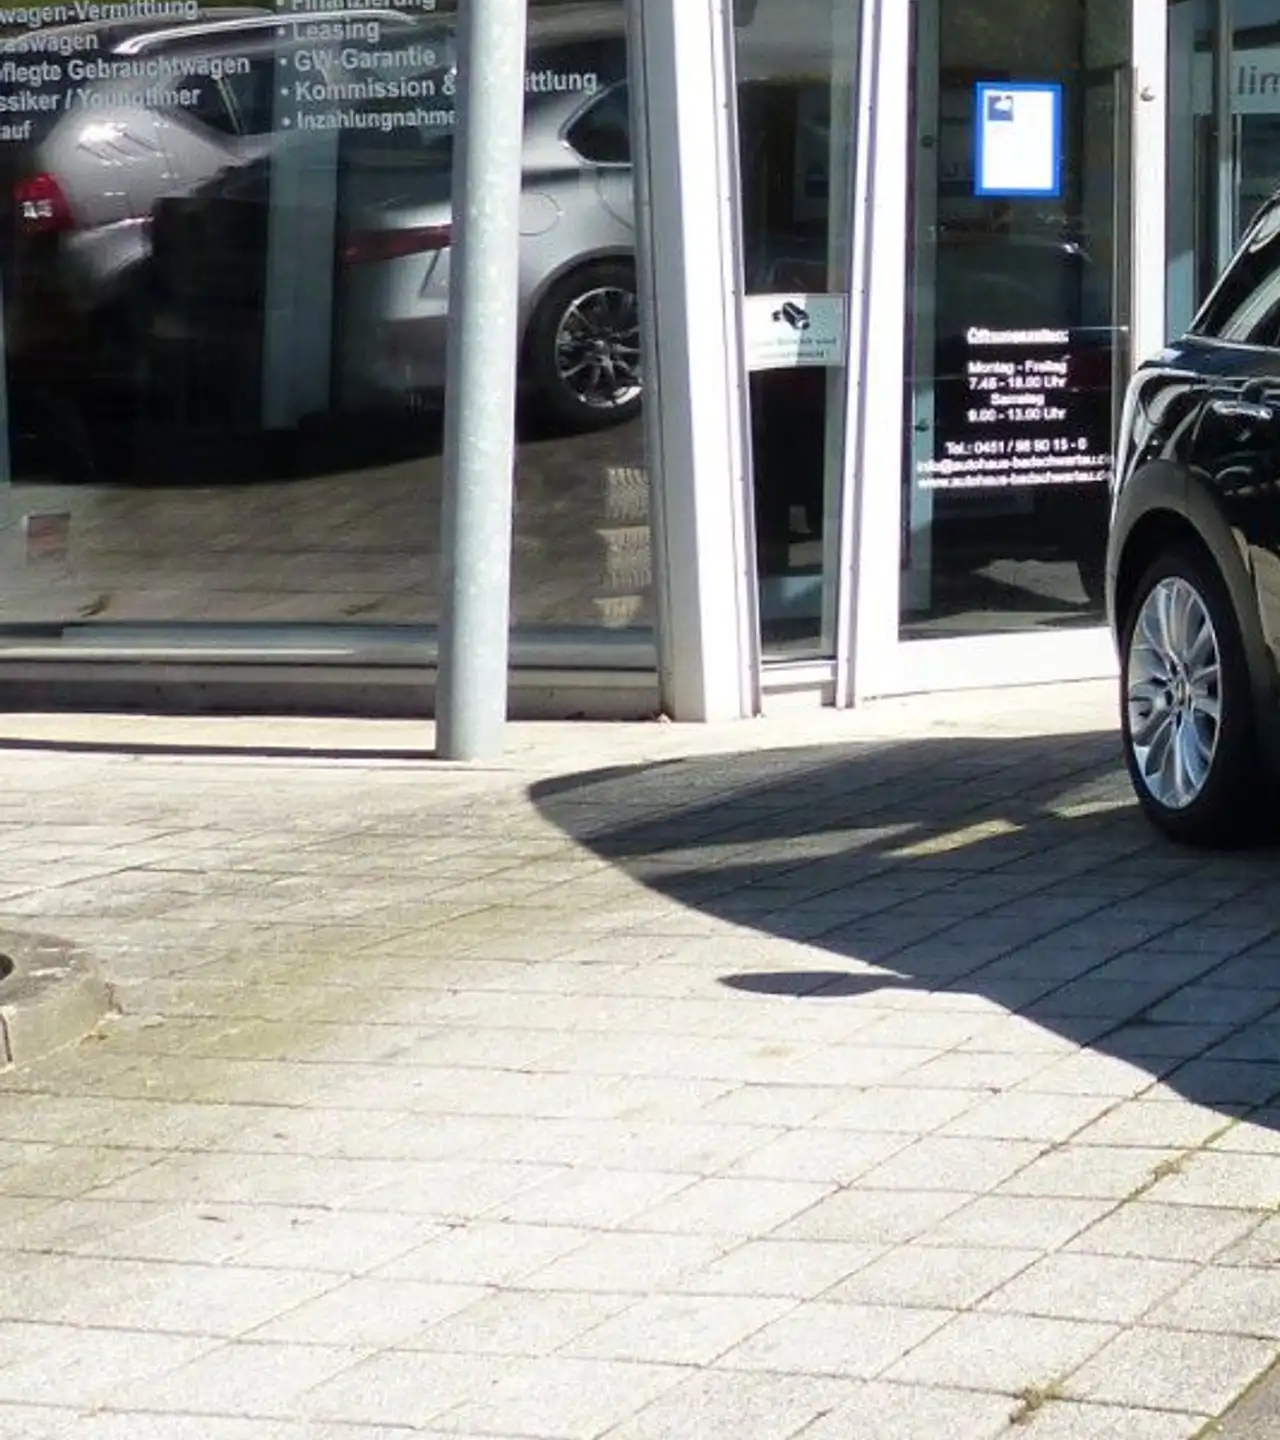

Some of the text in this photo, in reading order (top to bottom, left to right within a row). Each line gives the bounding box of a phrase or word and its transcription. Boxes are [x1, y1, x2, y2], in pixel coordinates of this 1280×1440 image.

[293, 20, 380, 43] Leasing
[295, 47, 436, 71] GW-Garantie
[0, 57, 249, 87] flegte Gebrauchtwagen
[296, 71, 598, 101] Kommission & ittlung
[77, 87, 201, 111] Youngtimer
[967, 361, 1015, 375] Montag
[1025, 360, 1068, 374] Freitag
[1044, 375, 1067, 388] Uhr
[1044, 407, 1067, 420] Uhr
